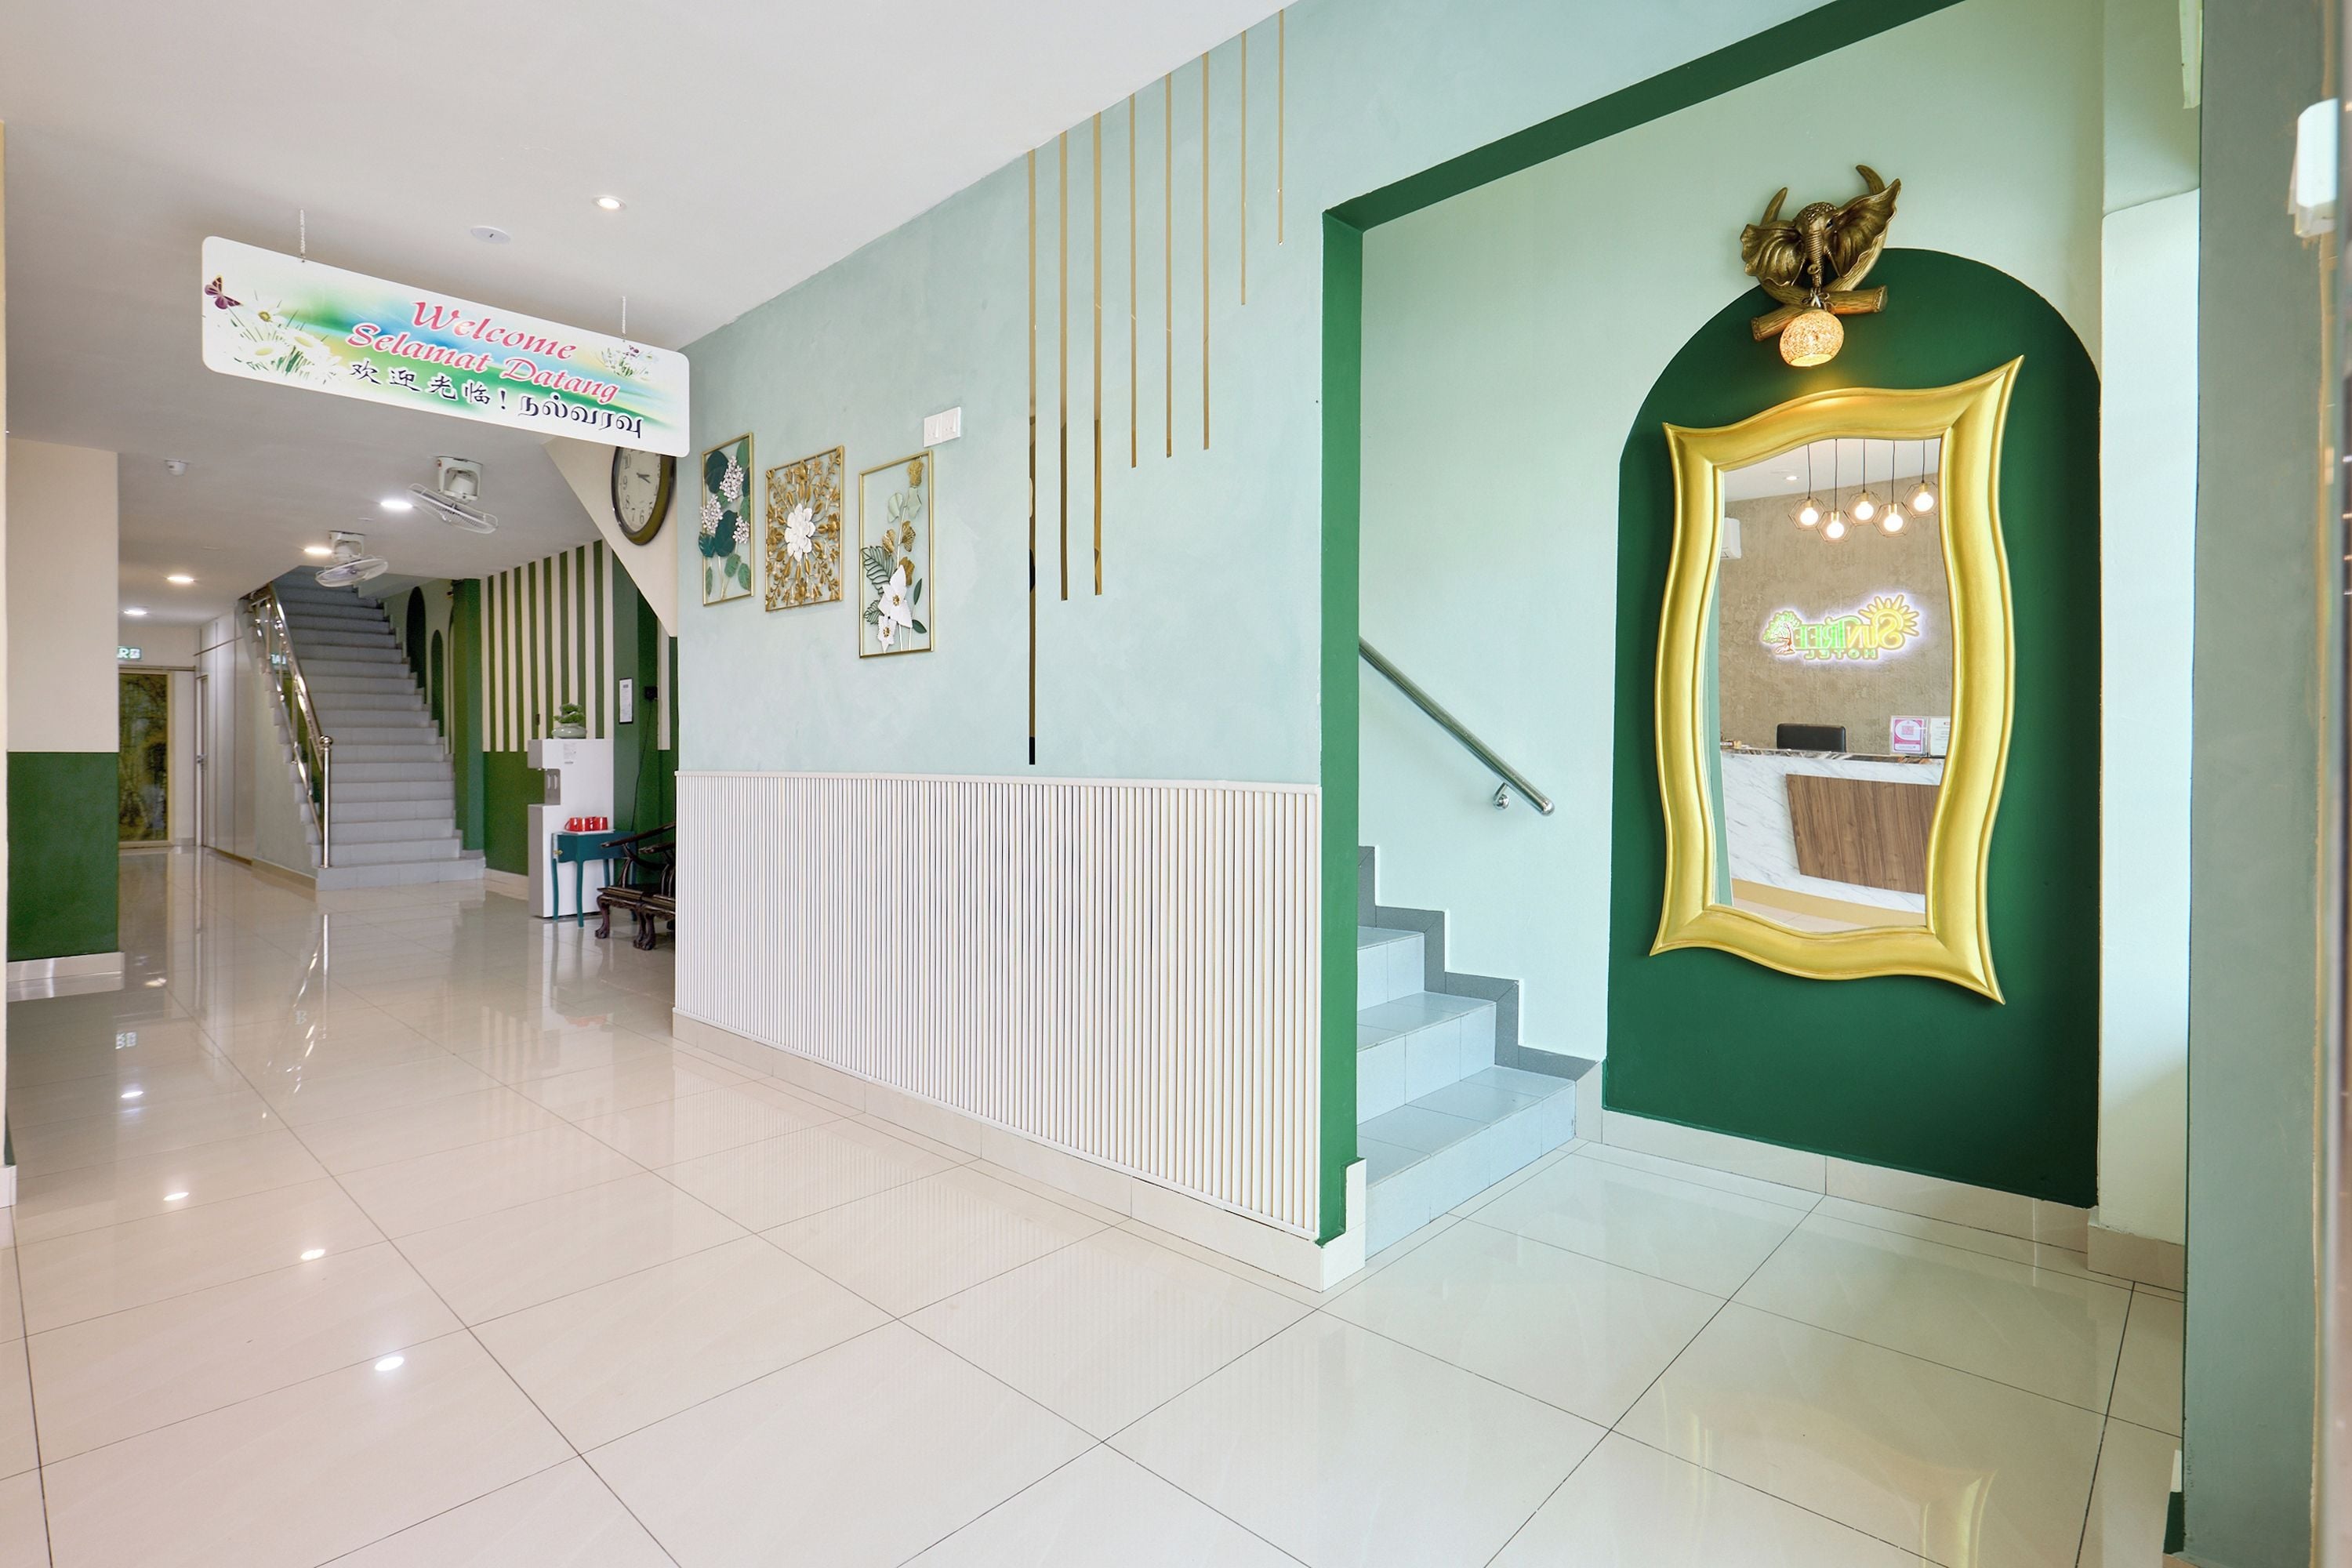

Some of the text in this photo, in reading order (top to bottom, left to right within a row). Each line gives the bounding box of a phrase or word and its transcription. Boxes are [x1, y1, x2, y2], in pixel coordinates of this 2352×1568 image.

[412, 302, 577, 359] Welcome
[347, 325, 619, 404] Selamat Datang
[517, 394, 644, 439] நல்வரவு
